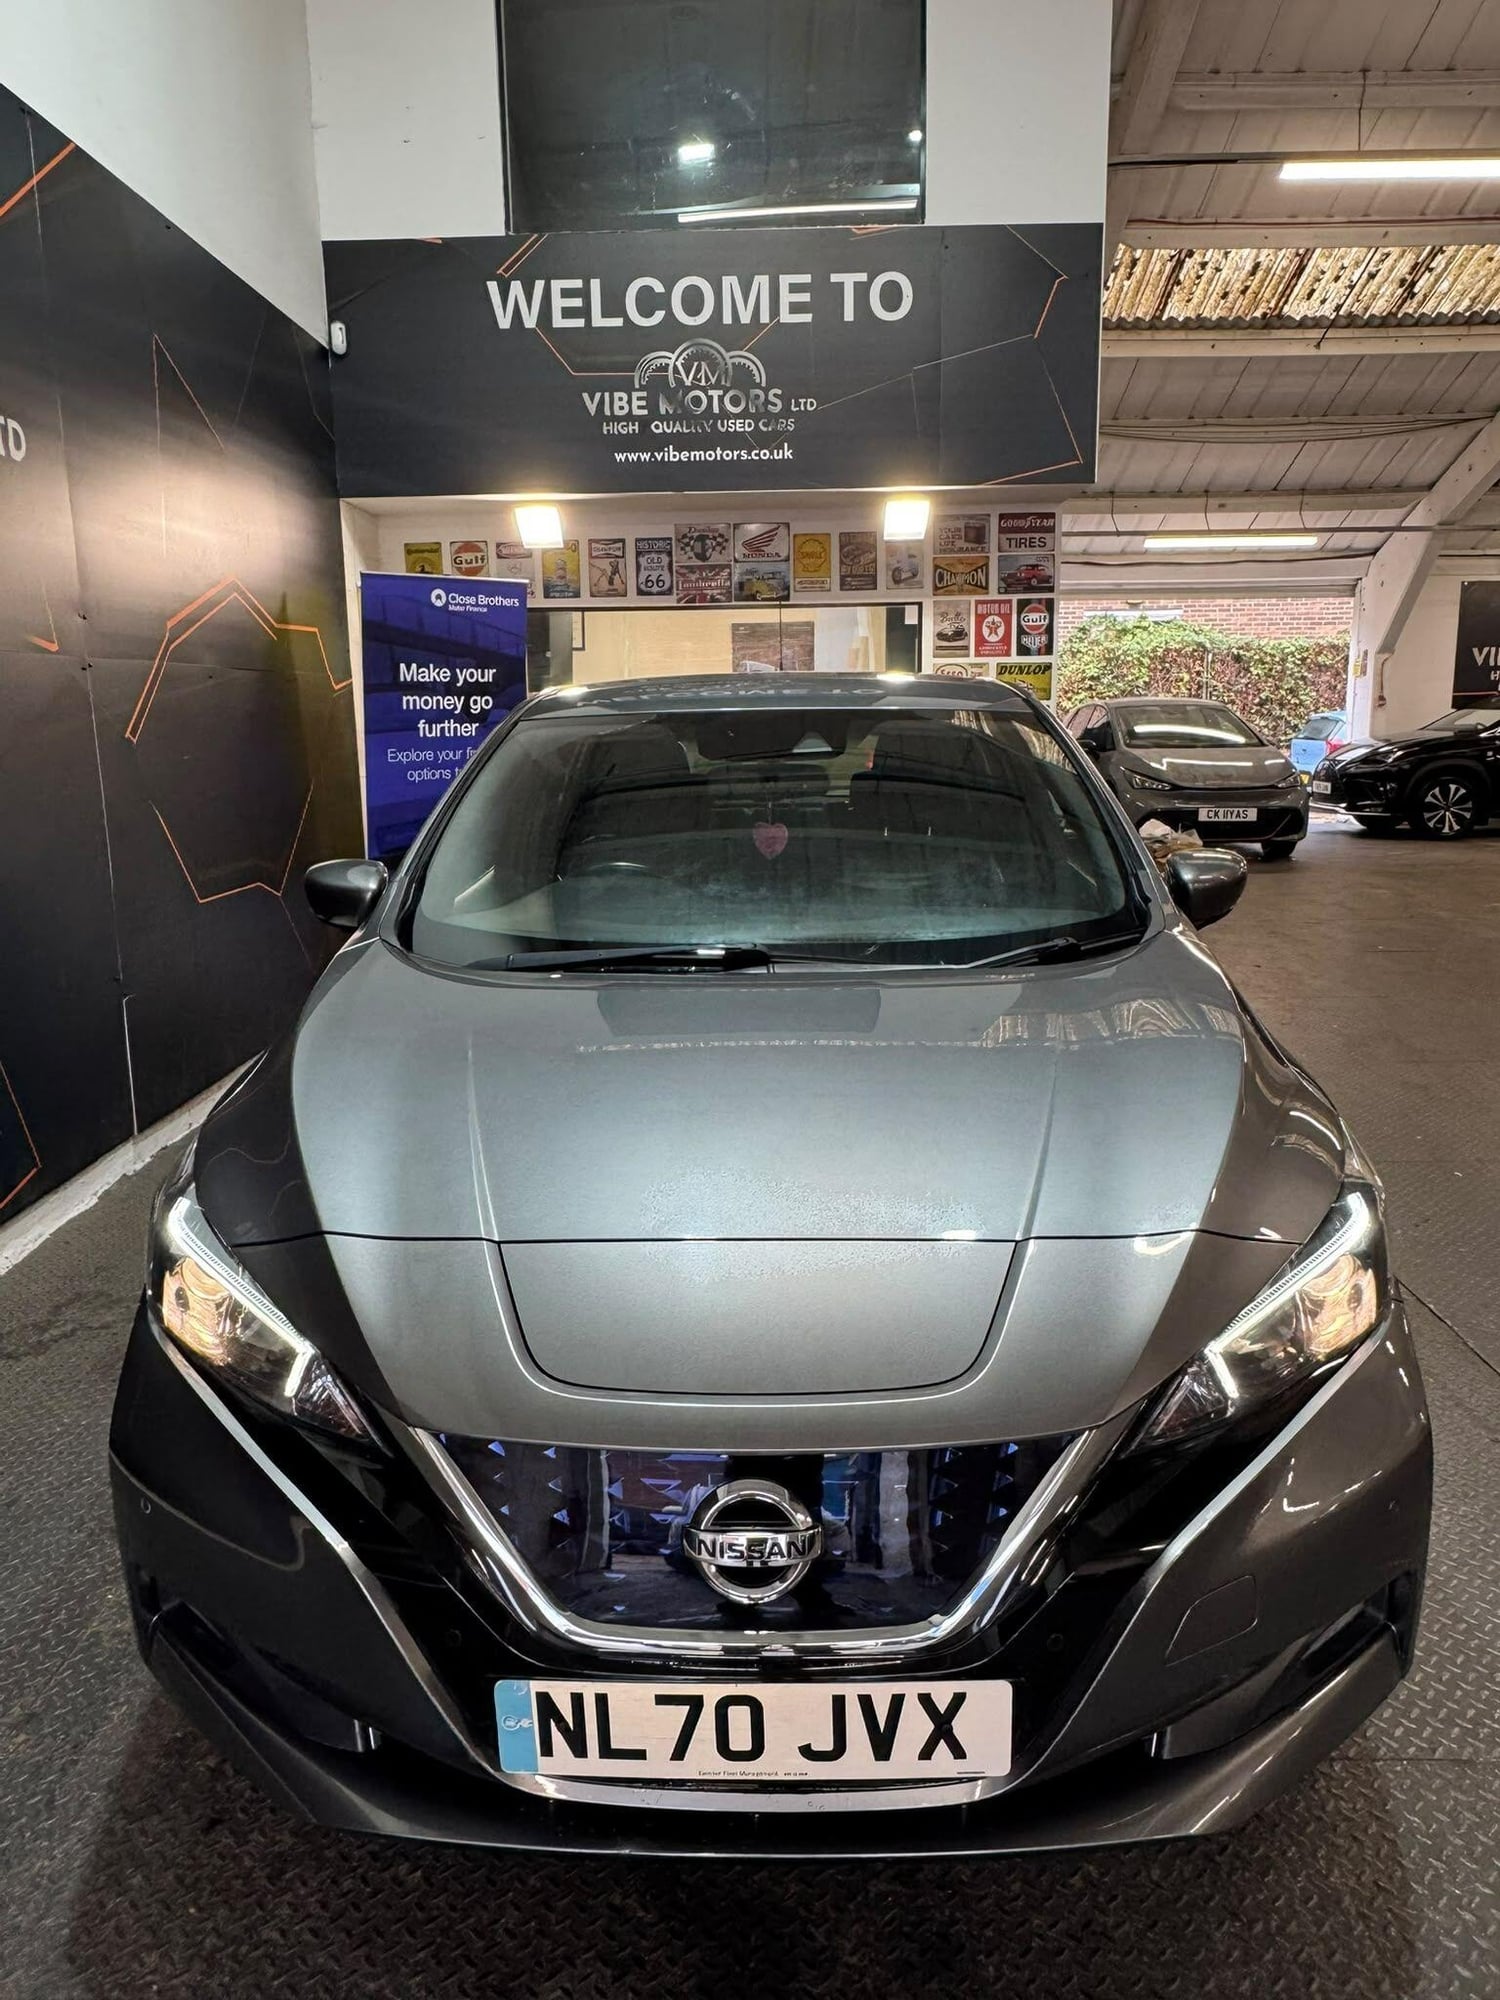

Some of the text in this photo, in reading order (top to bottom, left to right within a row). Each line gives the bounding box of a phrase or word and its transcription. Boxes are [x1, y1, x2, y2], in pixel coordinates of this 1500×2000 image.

[486, 271, 914, 329] WELCOME TO
[582, 388, 817, 416] VIBE MOTORS LTD
[603, 418, 796, 435] HIGH QUALITY USED CARS
[614, 443, 793, 463] www.vibemotors.co.uk
[1000, 516, 1055, 528] GOODYEAR
[636, 540, 671, 550] HISTORIC
[1006, 536, 1047, 549] TIRES
[453, 555, 486, 566] Gulf
[646, 556, 663, 565] OLD
[645, 574, 665, 589] 66
[448, 593, 520, 607] Close Brothers
[977, 603, 999, 615] MOTOR
[1022, 614, 1048, 624] Gulf
[400, 662, 496, 687] Make your
[998, 664, 1052, 676] DUNLOP
[402, 694, 493, 714] money go
[417, 719, 479, 737] further
[387, 748, 434, 764] Explore
[436, 749, 462, 763] your
[407, 768, 452, 783] options
[696, 1536, 808, 1561] NISSAN
[534, 1690, 968, 1763] NL70 JVX
